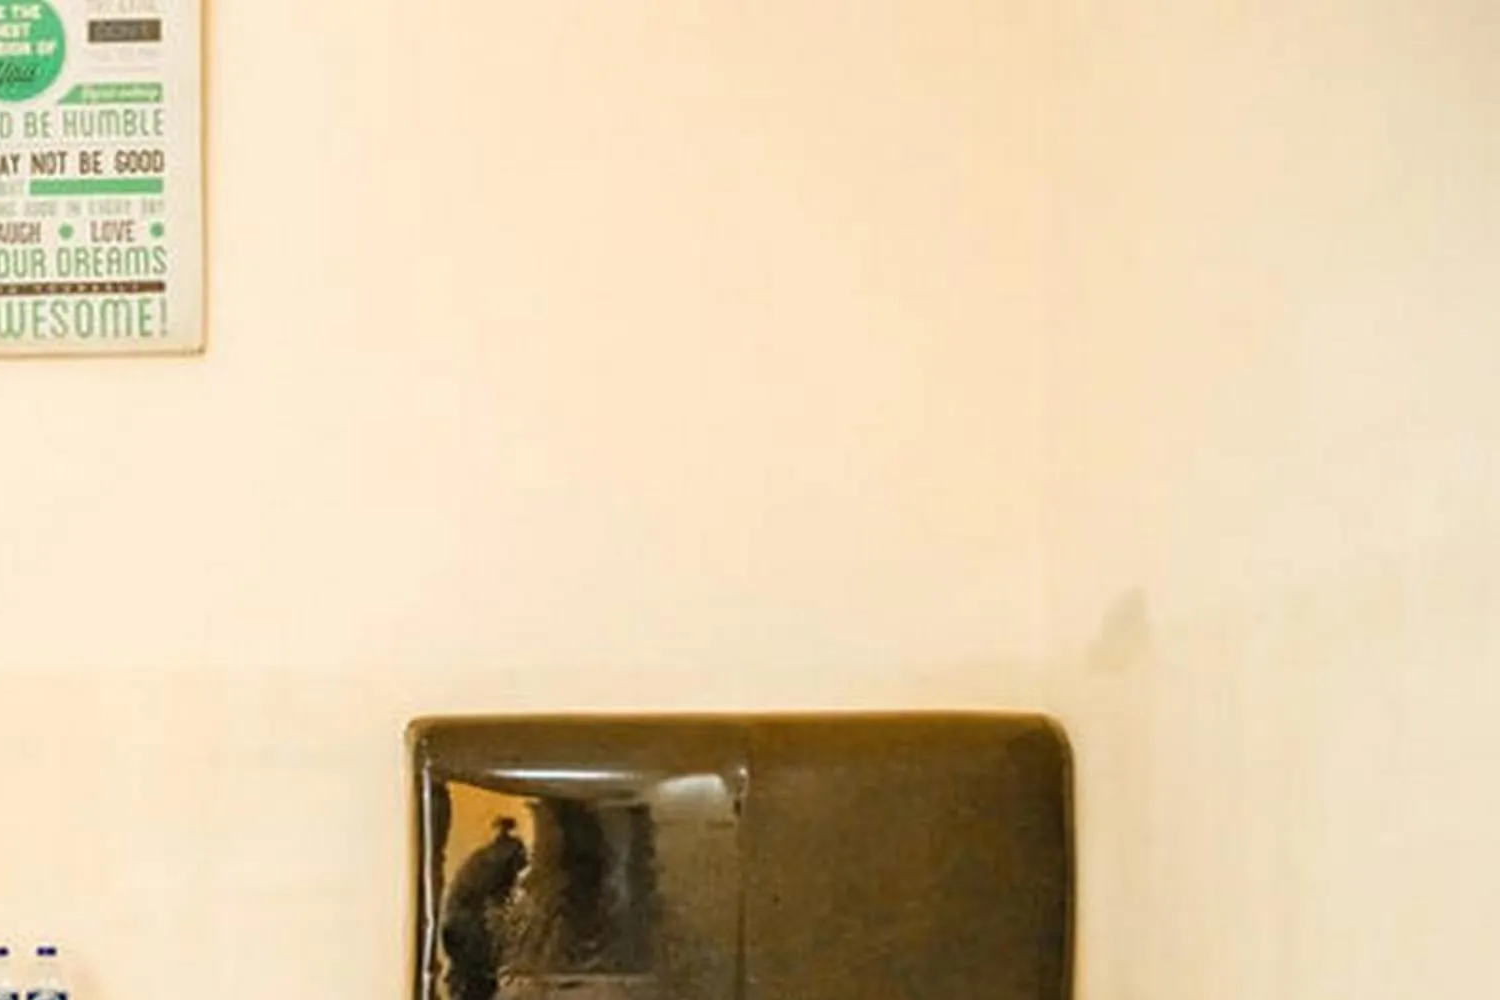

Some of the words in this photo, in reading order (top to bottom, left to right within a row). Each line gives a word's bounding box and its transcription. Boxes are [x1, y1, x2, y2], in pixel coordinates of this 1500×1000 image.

[23, 110, 50, 138] BE
[62, 108, 164, 138] HUMBLE
[30, 151, 68, 175] NOT
[78, 150, 103, 175] BE
[115, 149, 164, 174] GOOD
[90, 219, 135, 243] LOVE
[56, 244, 168, 276] DREAMS
